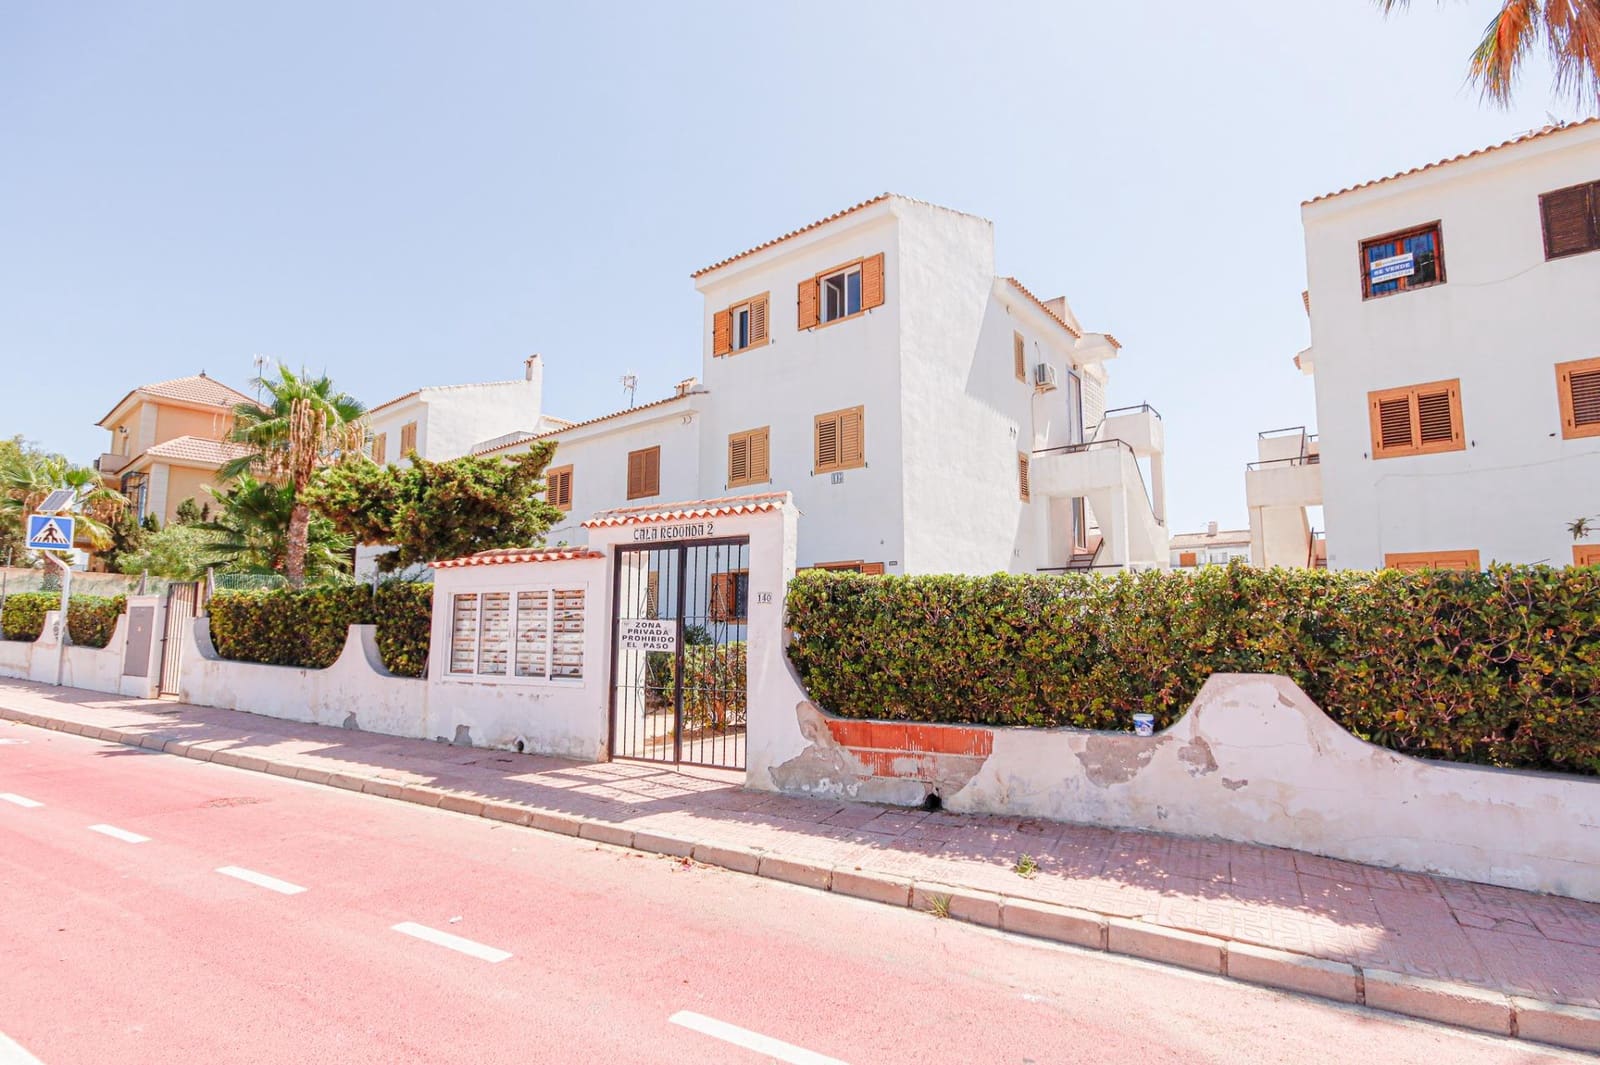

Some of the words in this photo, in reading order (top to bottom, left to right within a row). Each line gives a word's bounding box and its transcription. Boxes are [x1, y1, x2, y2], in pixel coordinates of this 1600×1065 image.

[1385, 262, 1411, 272] VENDE
[633, 528, 657, 541] CALA
[660, 524, 704, 539] REDONDA
[707, 523, 714, 535] 2
[627, 628, 669, 636] PRIVADA
[622, 634, 675, 643] PROHIBIDO
[643, 642, 669, 650] PASO
